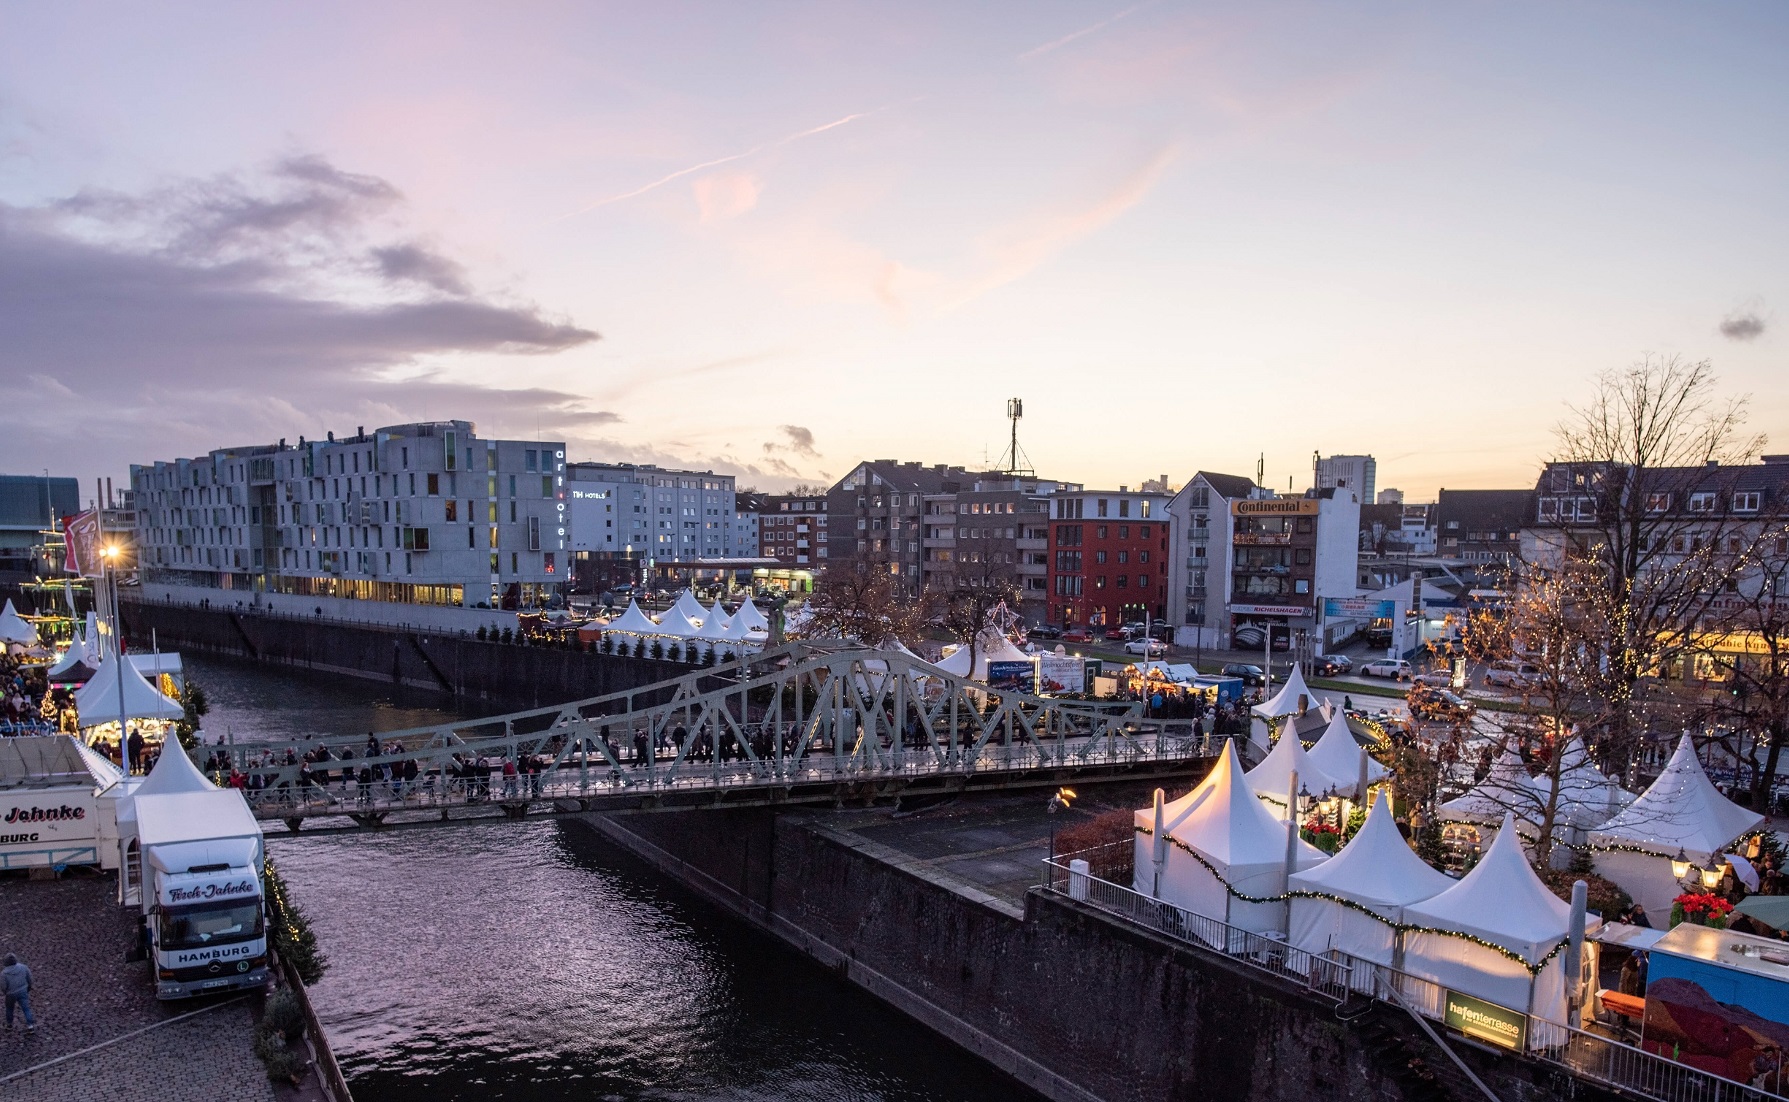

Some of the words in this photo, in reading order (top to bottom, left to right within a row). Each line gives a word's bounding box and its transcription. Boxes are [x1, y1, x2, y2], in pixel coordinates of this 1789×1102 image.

[1237, 501, 1300, 514] Continental
[1253, 606, 1303, 614] RICHELSHAGEN
[169, 880, 254, 902] Fisch-Jahnke
[178, 946, 249, 963] HAMBURG
[1449, 1001, 1519, 1034] hafenterrasse
